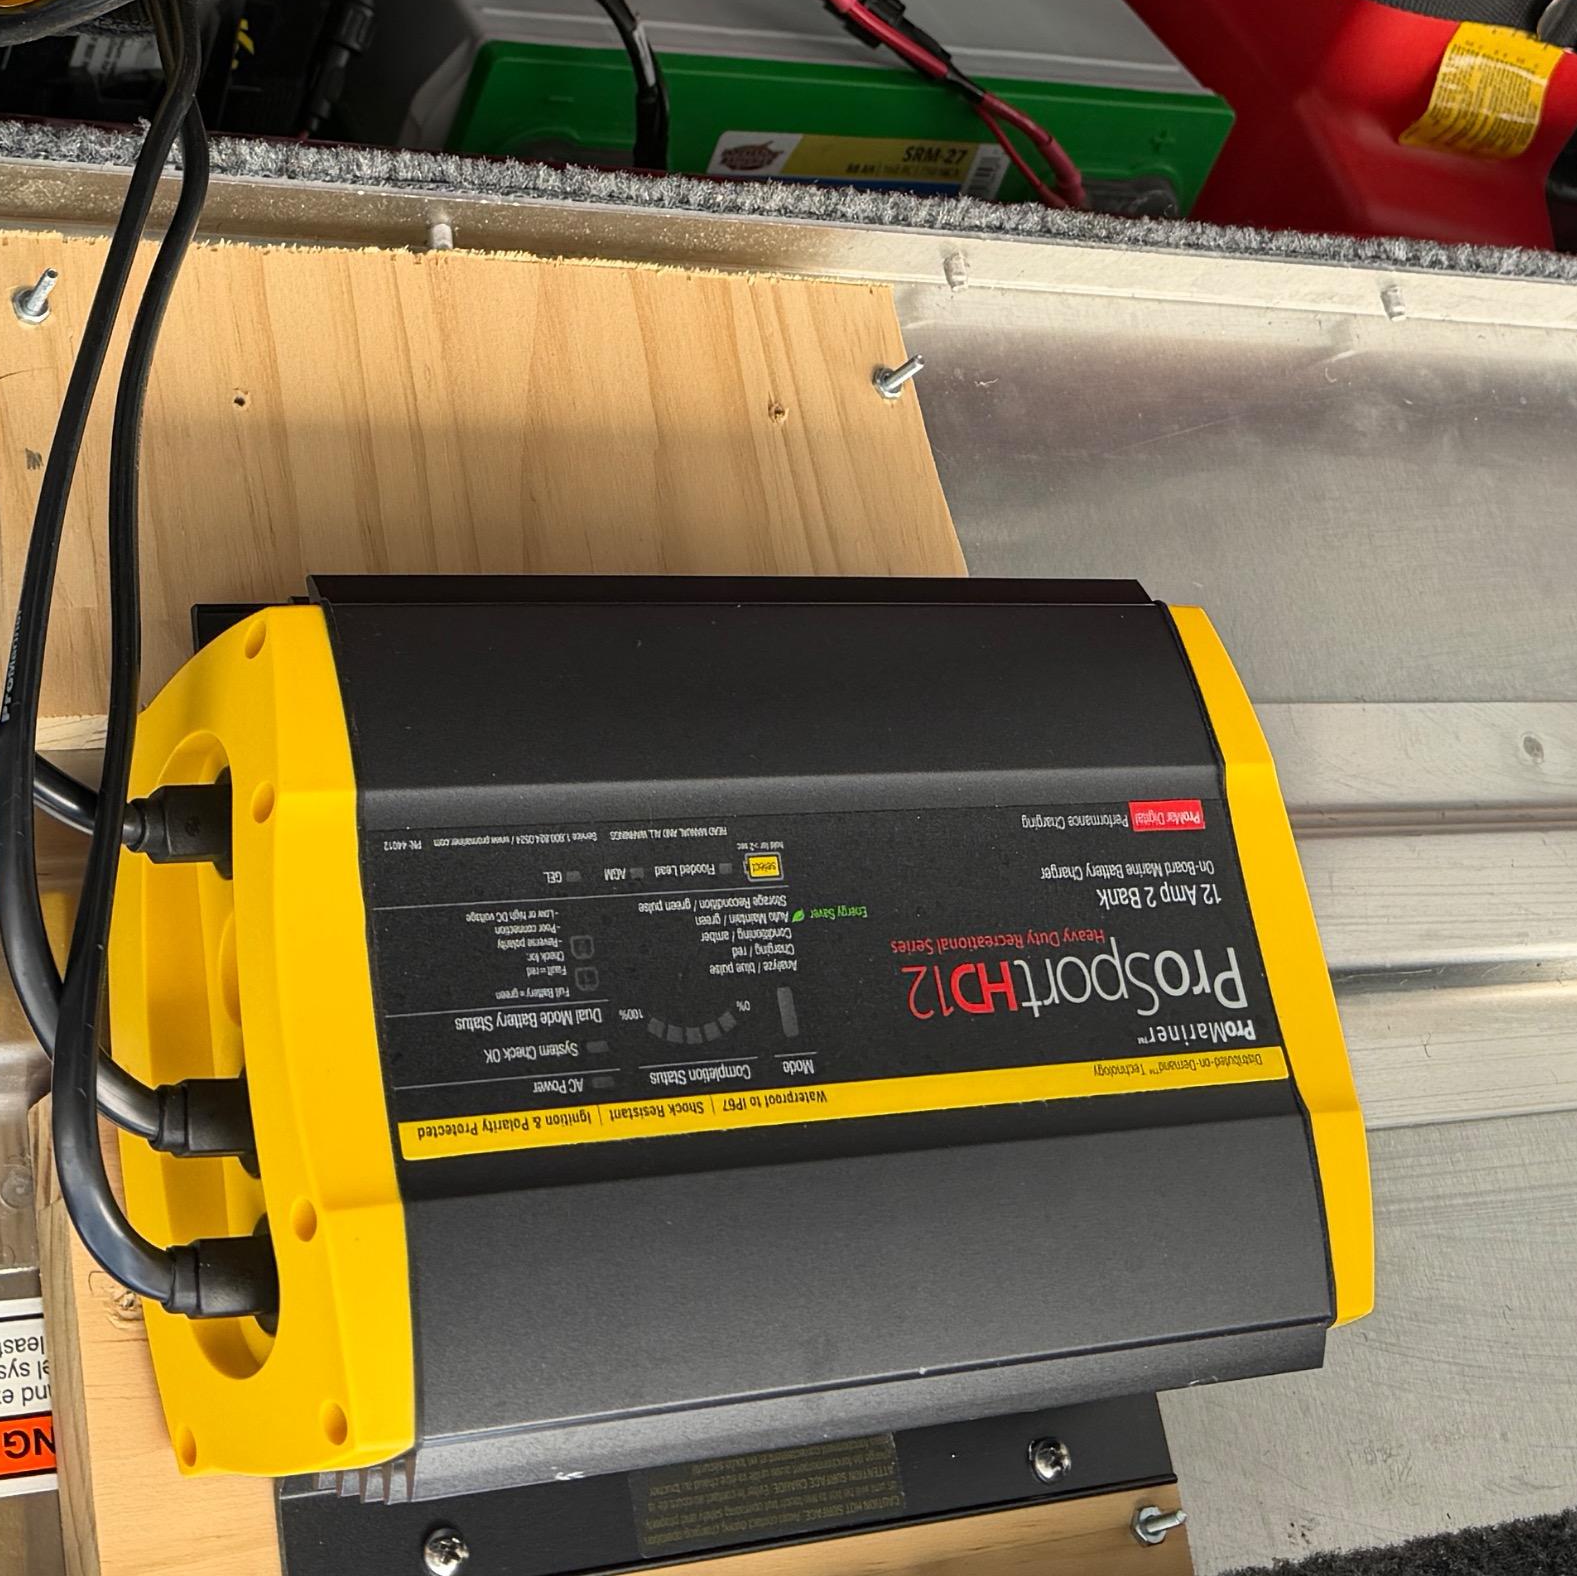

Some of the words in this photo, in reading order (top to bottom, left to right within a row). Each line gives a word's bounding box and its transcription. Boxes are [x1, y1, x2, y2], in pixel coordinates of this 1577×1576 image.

[903, 145, 967, 165] SRM-27
[1021, 815, 1066, 830] Charging
[1067, 813, 1128, 828] Performance
[1134, 811, 1165, 825] Digital
[1166, 810, 1201, 825] ProMar
[603, 867, 626, 881] AGM
[654, 865, 678, 877] Lead
[680, 863, 715, 876] Flooded
[751, 861, 776, 873] select
[1040, 864, 1083, 880] Charger
[1085, 861, 1124, 879] Battery
[1126, 862, 1163, 877] Marine
[1164, 859, 1215, 876] On-Board
[543, 871, 562, 883] GEL
[753, 893, 787, 906] Storage
[1096, 887, 1140, 910] Bank
[1143, 886, 1156, 908] 2
[1160, 881, 1196, 906] Amp
[1201, 882, 1222, 905] 12
[638, 900, 663, 913] pulse
[665, 897, 691, 911] green
[699, 896, 750, 910] Recondition
[695, 913, 721, 925] green
[728, 912, 767, 925] Maintain
[768, 911, 789, 923] Auto
[810, 907, 835, 920] Saver
[837, 905, 867, 918] Energy
[701, 930, 729, 943] amber
[737, 927, 792, 940] Conditioning
[1026, 929, 1059, 948] Duty
[1062, 928, 1104, 947] Heavy
[755, 942, 795, 956] Charging
[890, 939, 934, 955] Series
[937, 934, 1022, 954] Recreational
[732, 946, 747, 958] red
[709, 963, 734, 975] pulse
[736, 962, 755, 974] blue
[763, 958, 797, 973] Analyze
[496, 1011, 537, 1030] Battery
[540, 1009, 573, 1027] Mode
[575, 1007, 602, 1025] Dual
[619, 1008, 643, 1020] 100%
[454, 1015, 494, 1032] Status
[483, 1048, 501, 1063] OK
[503, 1045, 536, 1061] Check
[538, 1040, 578, 1060] System
[688, 1063, 751, 1084] Completion
[782, 1059, 814, 1076] Mode
[1093, 1061, 1145, 1078] Technology
[568, 1077, 584, 1092] AC
[649, 1070, 687, 1086] Status
[532, 1079, 566, 1094] Power
[722, 1097, 746, 1111] IP67
[764, 1090, 827, 1108] Waterproof
[609, 1105, 664, 1121] Resistant
[668, 1101, 704, 1118] Shock
[545, 1109, 591, 1127] Ignition
[417, 1122, 477, 1140] Protected
[482, 1118, 528, 1134] Polarity
[22, 1384, 51, 1406] nd
